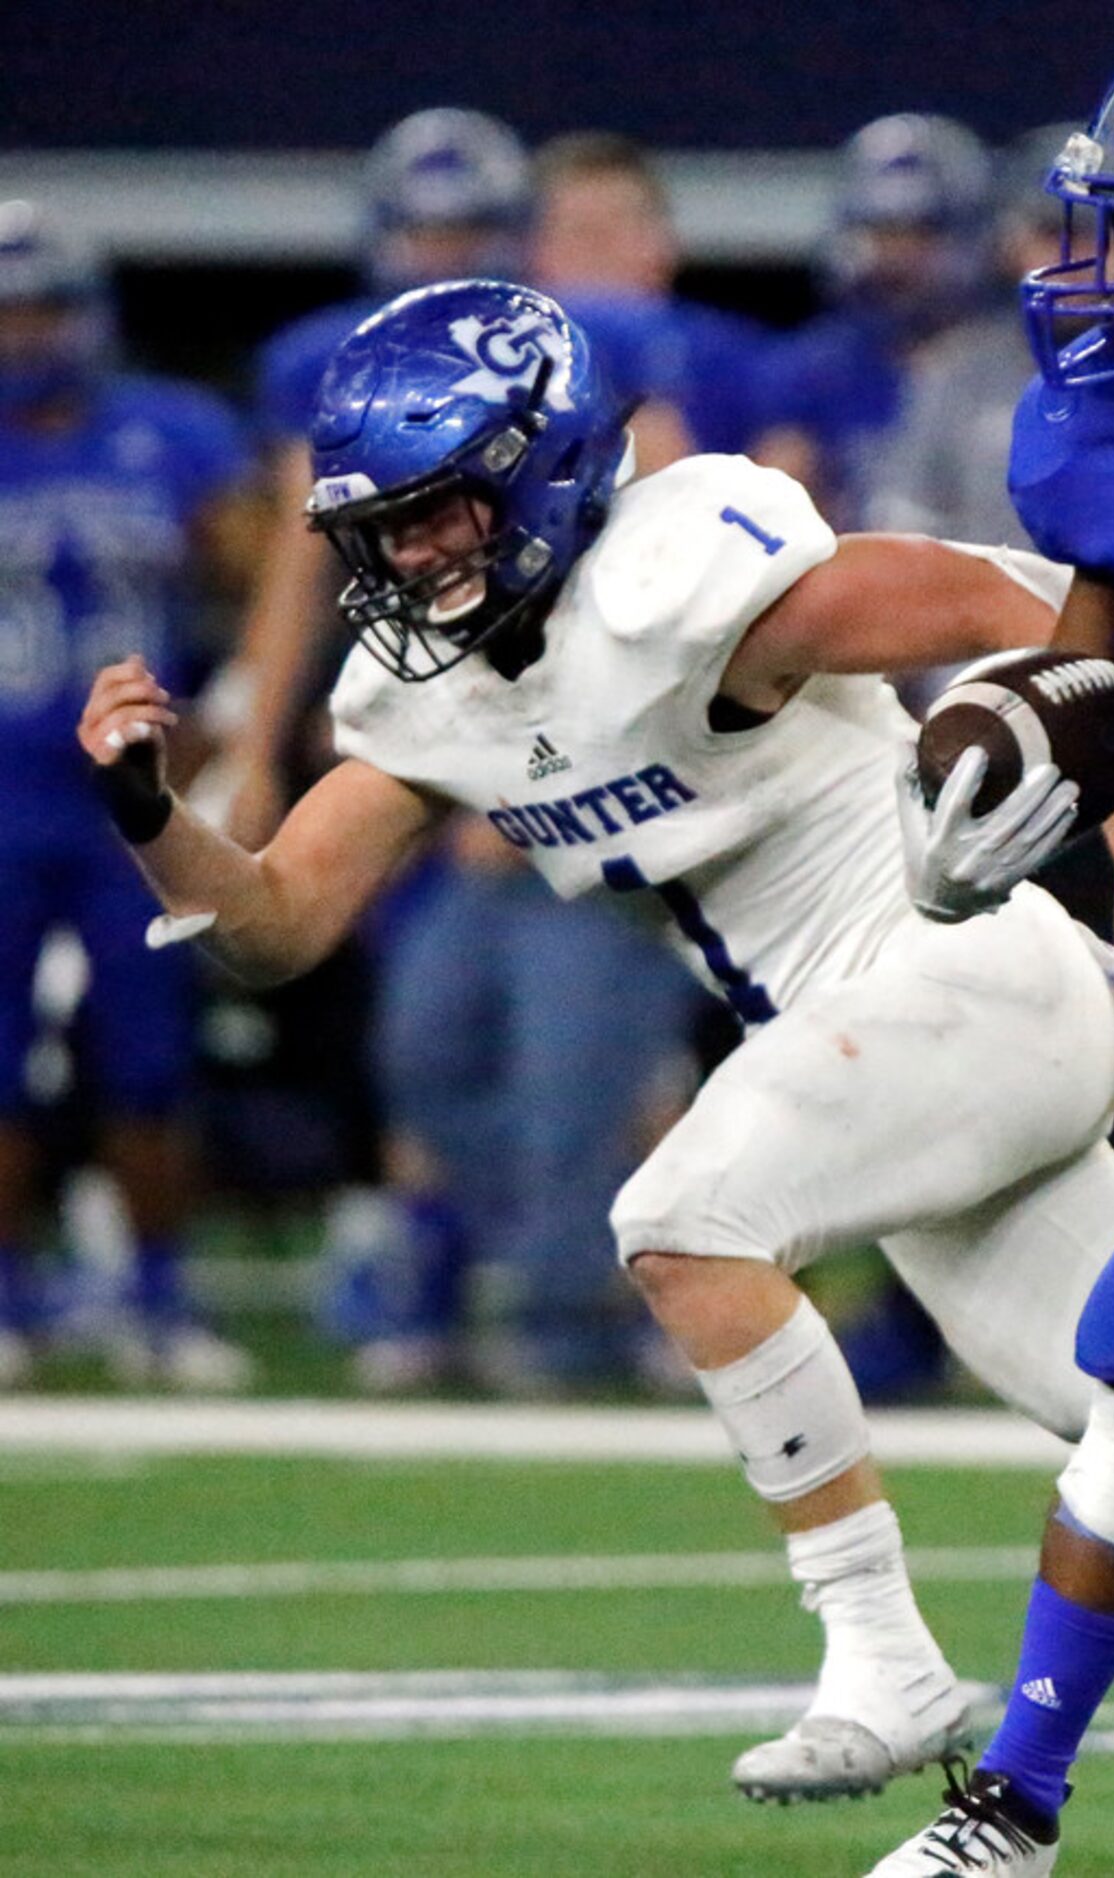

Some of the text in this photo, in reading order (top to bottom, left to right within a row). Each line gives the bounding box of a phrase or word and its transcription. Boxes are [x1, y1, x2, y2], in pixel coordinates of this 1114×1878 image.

[719, 505, 786, 555] 1
[487, 763, 699, 849] GUNTER
[601, 853, 780, 1024] 1
